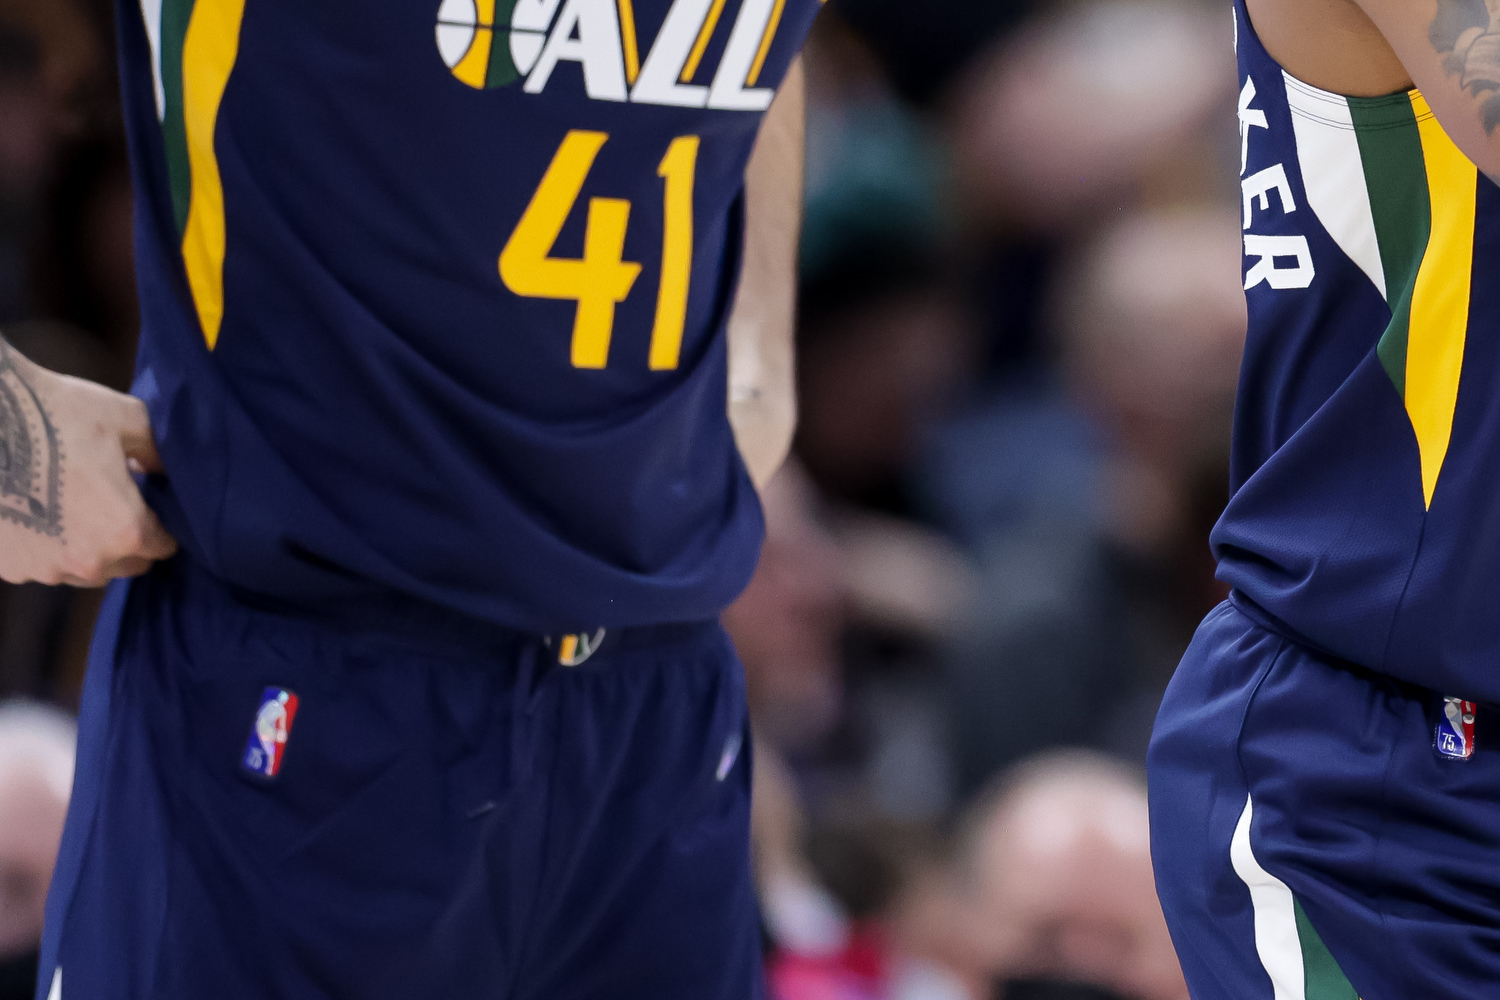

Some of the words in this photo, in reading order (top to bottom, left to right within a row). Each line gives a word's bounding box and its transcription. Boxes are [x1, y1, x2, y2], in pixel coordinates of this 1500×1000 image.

[497, 129, 701, 371] 41
[1232, 7, 1316, 290] KER
[1442, 732, 1456, 752] 75
